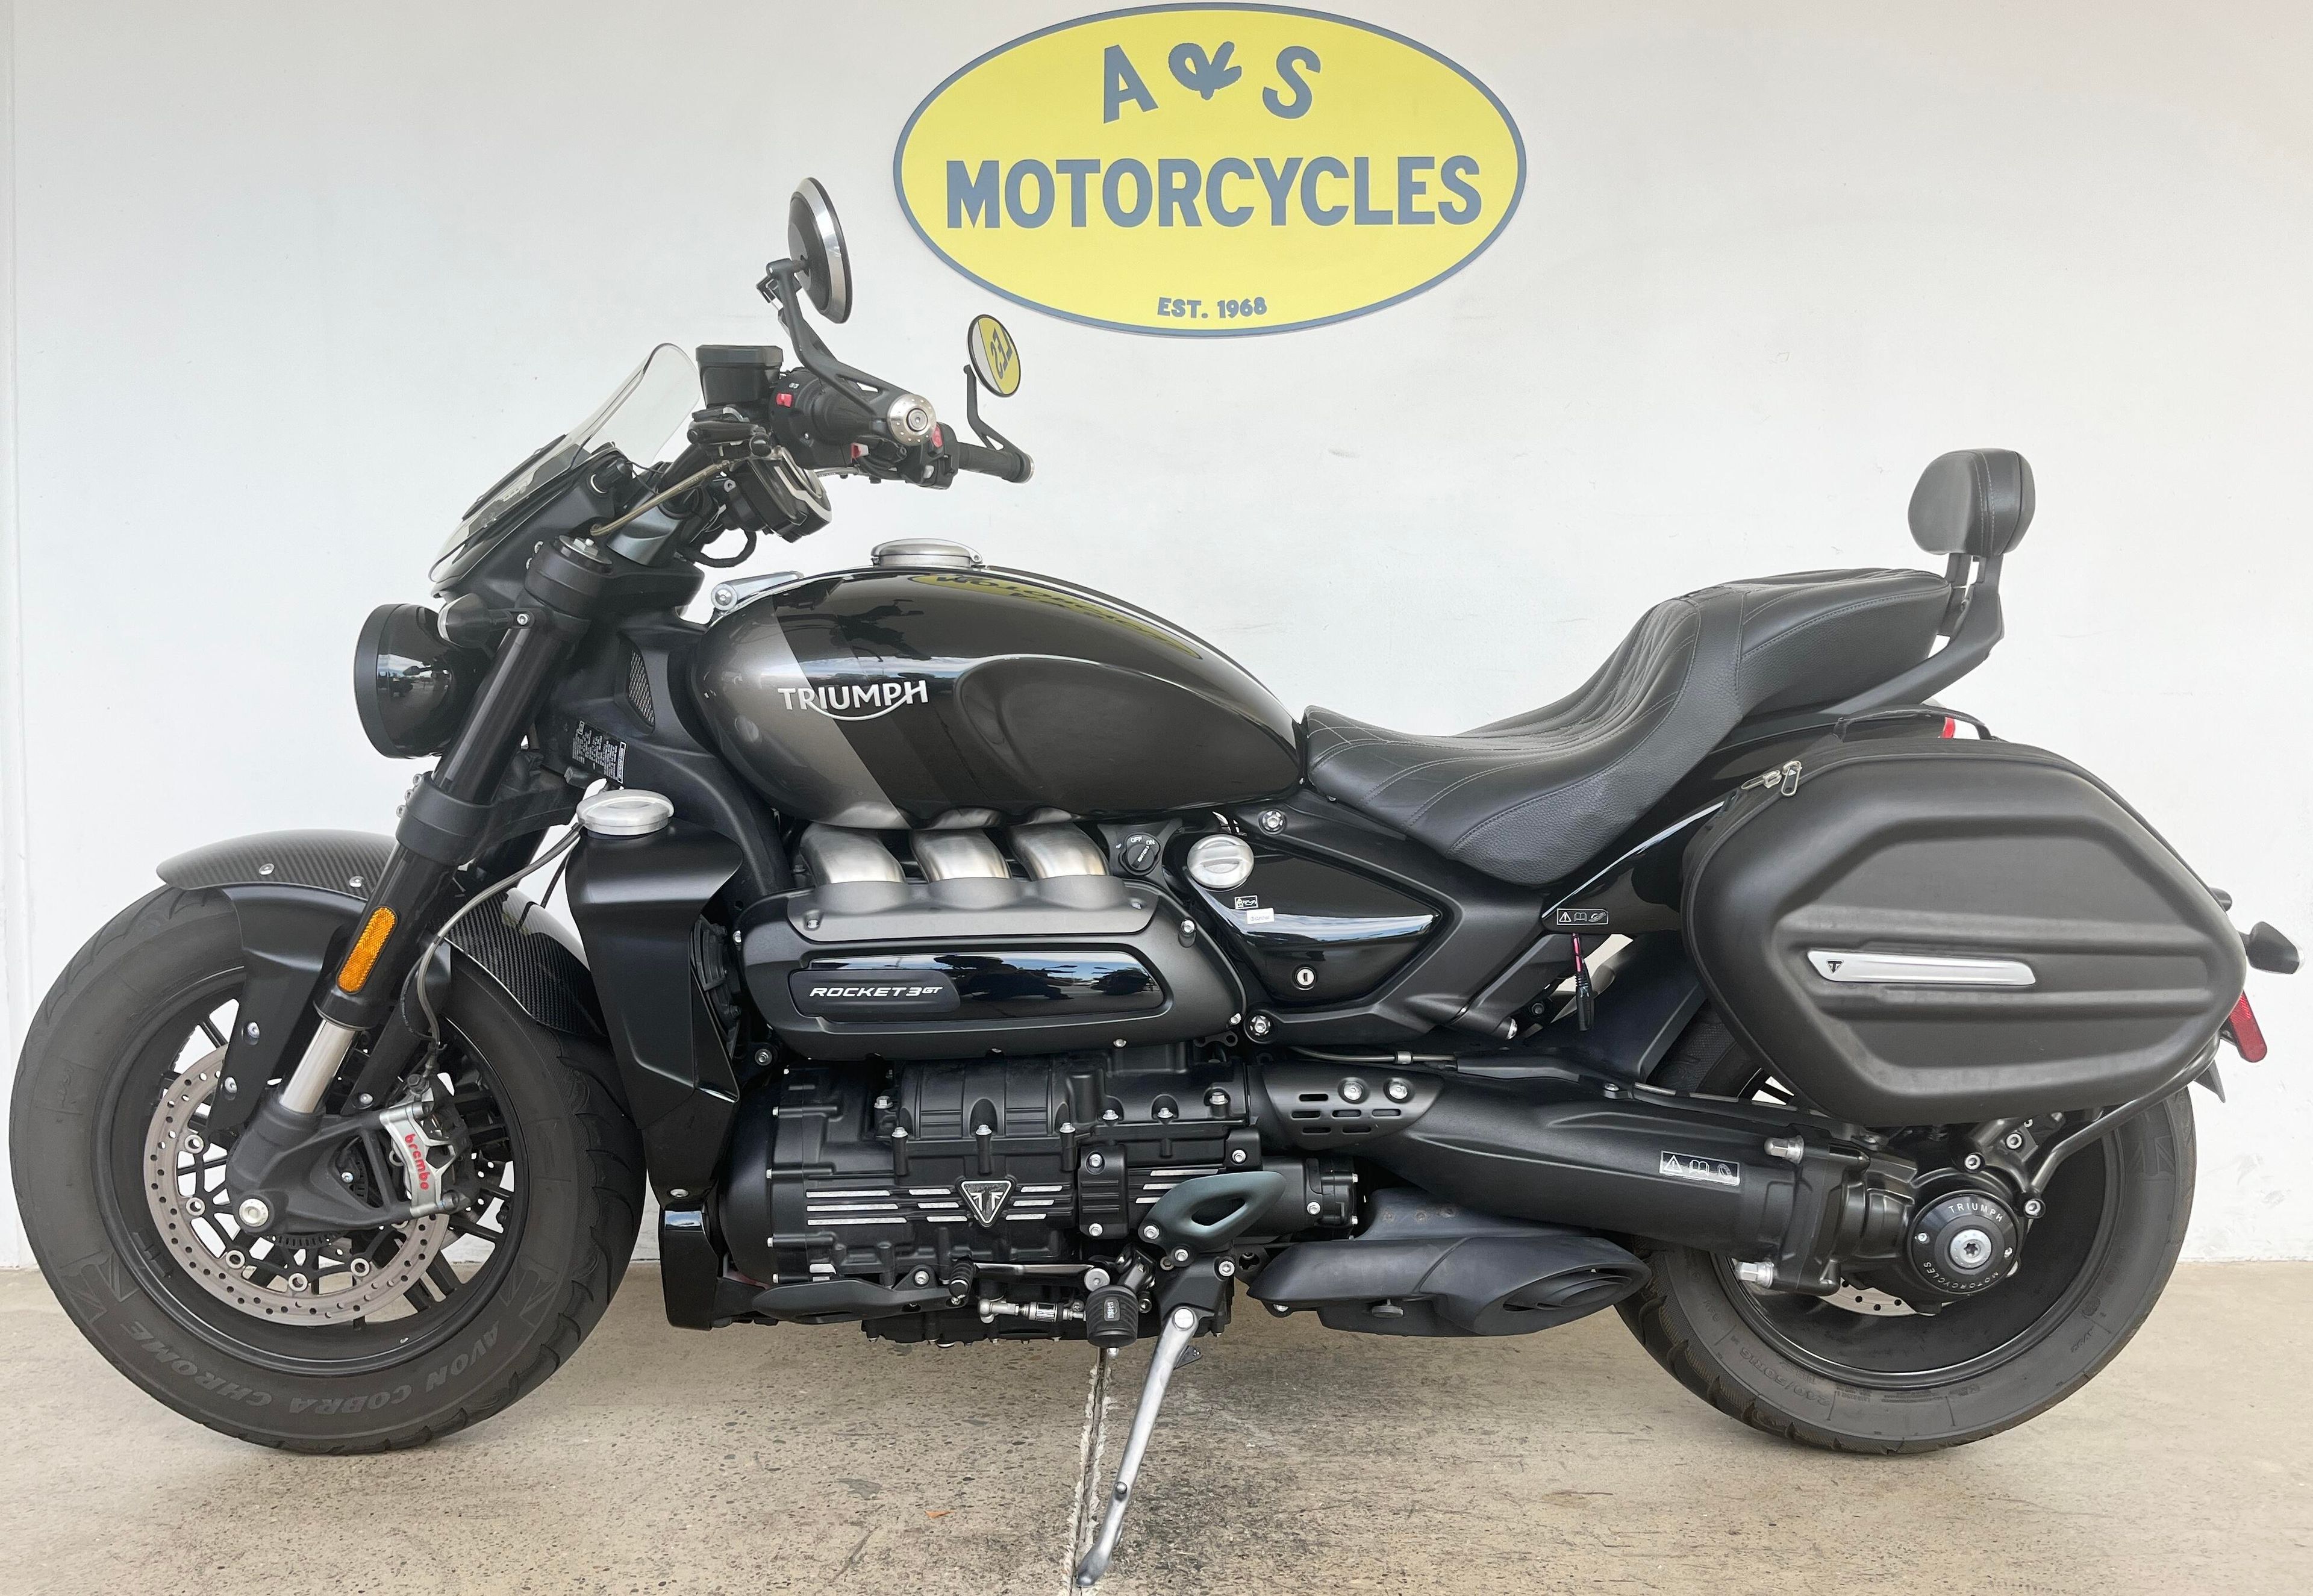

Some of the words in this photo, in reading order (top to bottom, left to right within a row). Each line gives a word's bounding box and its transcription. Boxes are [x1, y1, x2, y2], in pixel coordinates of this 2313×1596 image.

[1103, 45, 1158, 124] A
[1263, 46, 1321, 120] S
[946, 155, 1482, 229] MOTORCYCLES
[1157, 297, 1208, 318] EST.
[1217, 296, 1267, 318] 1968
[778, 680, 928, 721] TRIUMPH
[404, 1133, 430, 1190] brembo
[1949, 1202, 2003, 1222] TRIUMPH
[1923, 1261, 1999, 1289] MOTORCYCLES
[120, 1321, 272, 1407] CHROME
[425, 1321, 499, 1392] AVON
[289, 1385, 413, 1415] COBRA
